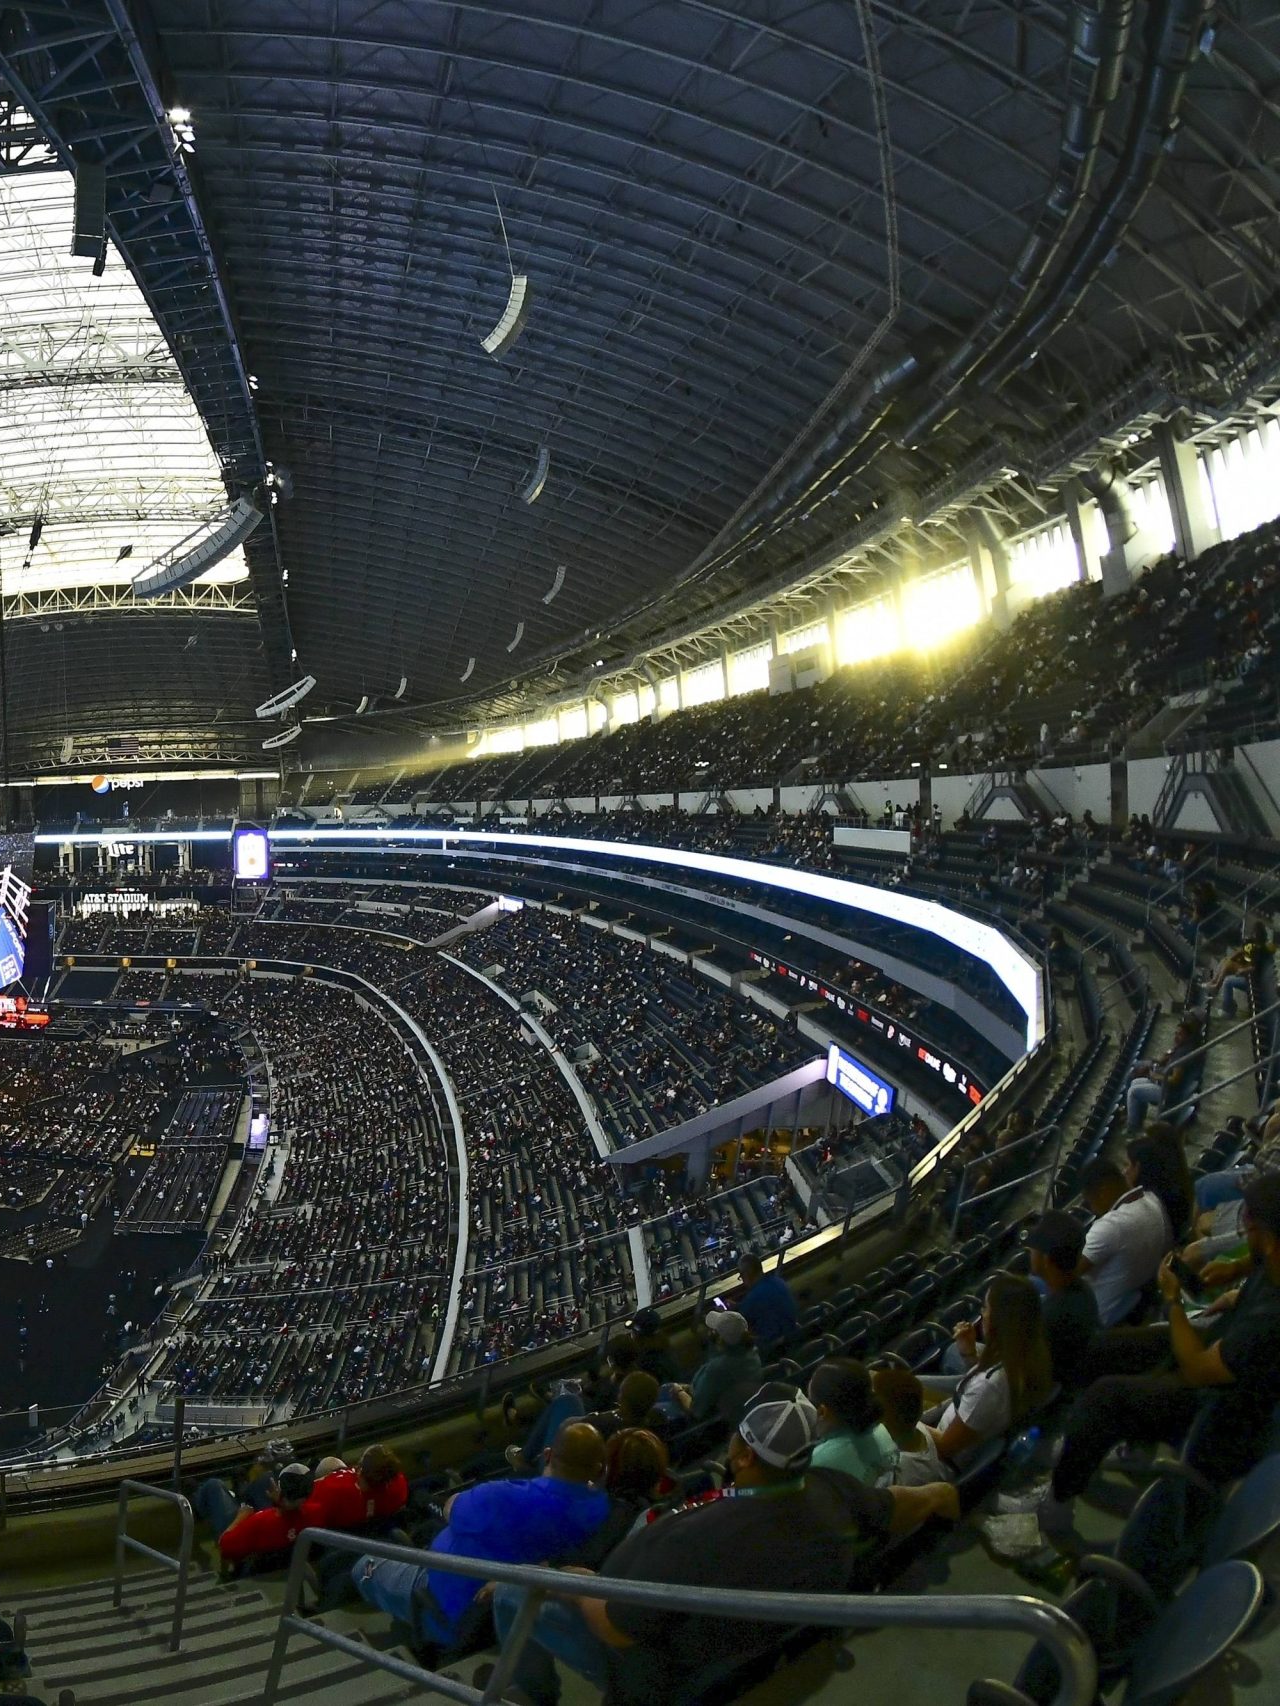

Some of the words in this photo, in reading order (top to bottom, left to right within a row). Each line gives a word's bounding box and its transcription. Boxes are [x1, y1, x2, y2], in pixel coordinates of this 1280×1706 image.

[111, 779, 144, 791] pepsi
[83, 893, 106, 904] AT&T
[107, 893, 149, 904] STADIUM
